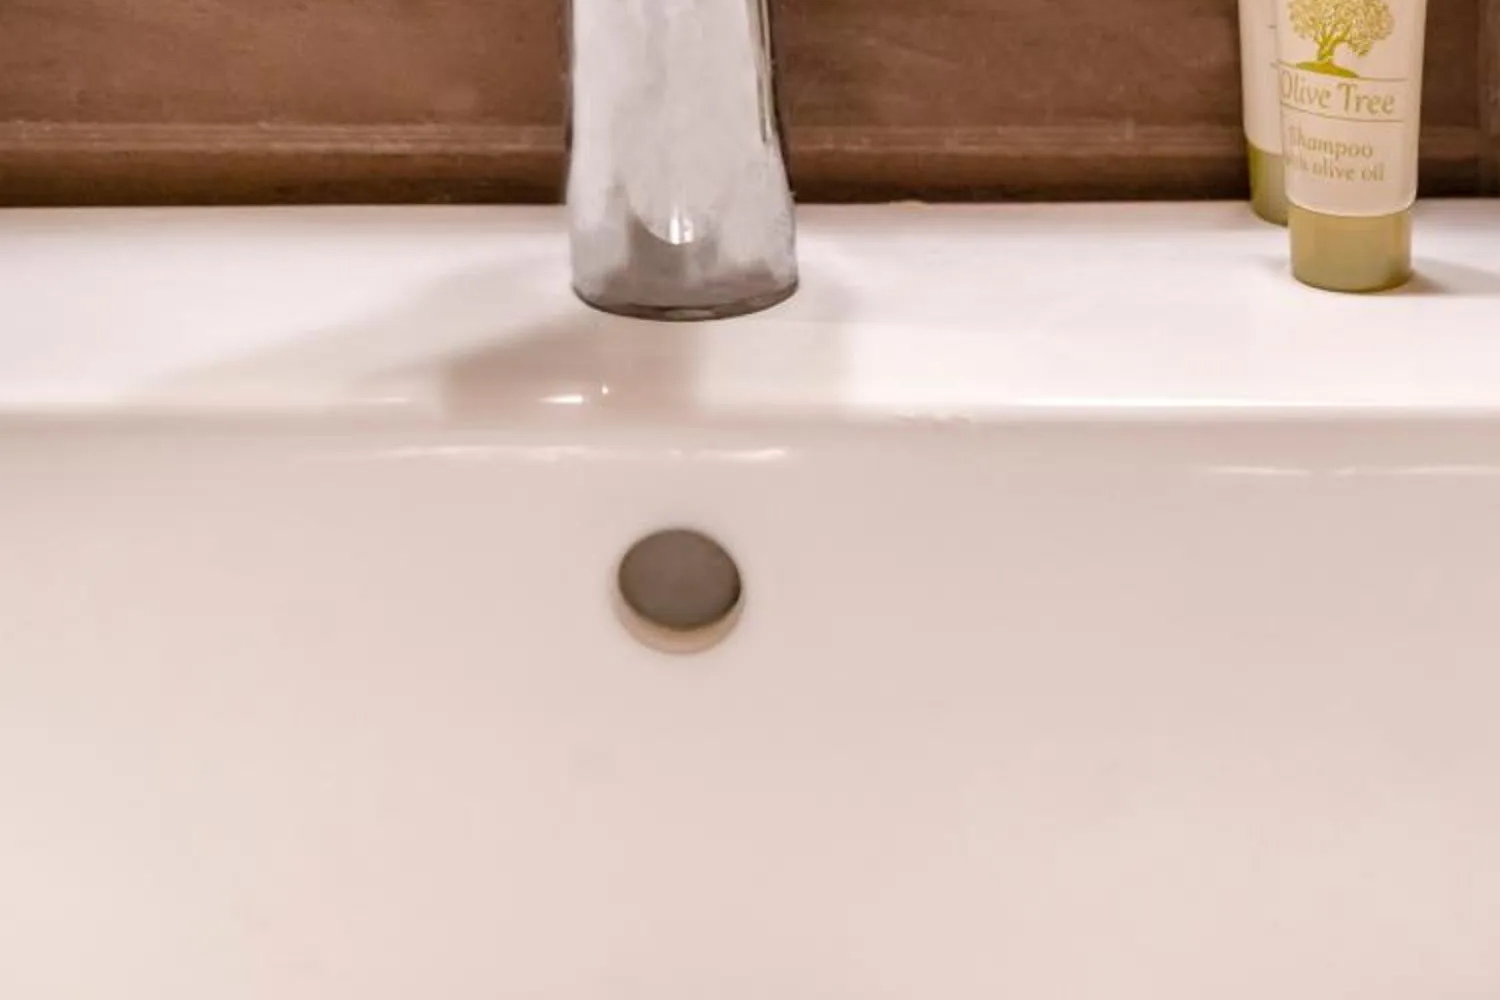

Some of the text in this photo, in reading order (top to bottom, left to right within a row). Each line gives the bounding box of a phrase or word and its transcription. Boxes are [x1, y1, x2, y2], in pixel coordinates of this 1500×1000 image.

[1280, 70, 1396, 115] Olive Tree
[1312, 156, 1356, 182] olive
[1361, 164, 1386, 182] oil
